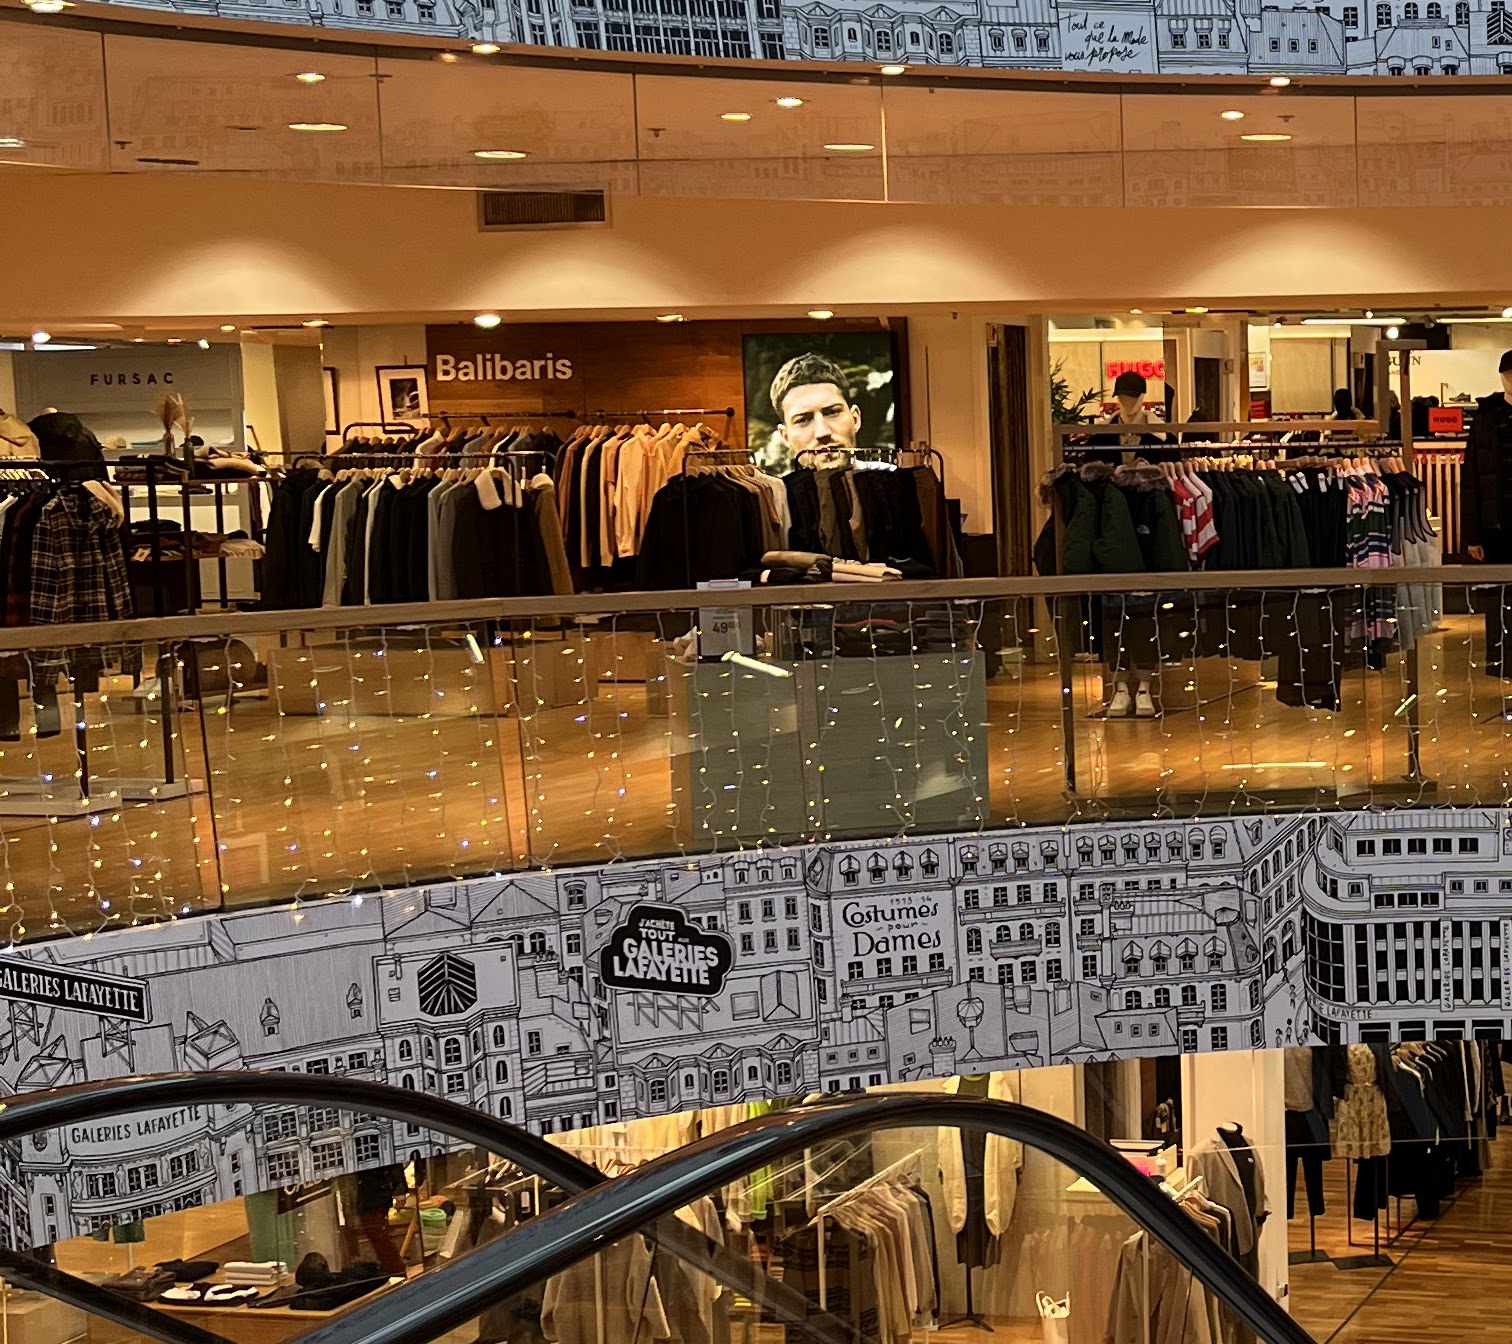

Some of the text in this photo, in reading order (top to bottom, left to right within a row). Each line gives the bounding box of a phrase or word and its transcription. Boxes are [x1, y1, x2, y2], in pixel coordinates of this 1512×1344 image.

[1084, 30, 1105, 50] que
[1107, 24, 1119, 43] la
[1093, 21, 1105, 30] ce
[89, 372, 174, 385] FURSAC
[436, 352, 574, 382] Balibaris
[1432, 416, 1458, 424] HUGO
[842, 902, 939, 928] Costumes
[887, 921, 919, 933] pour
[638, 928, 676, 942] TOUT
[852, 929, 942, 957] Dames
[623, 937, 719, 967] GALERIES
[613, 955, 710, 986] LAFAYETTE
[63, 979, 140, 1012] LAFAYETTE
[71, 1105, 202, 1144] GALERIES LAFAYETTE
